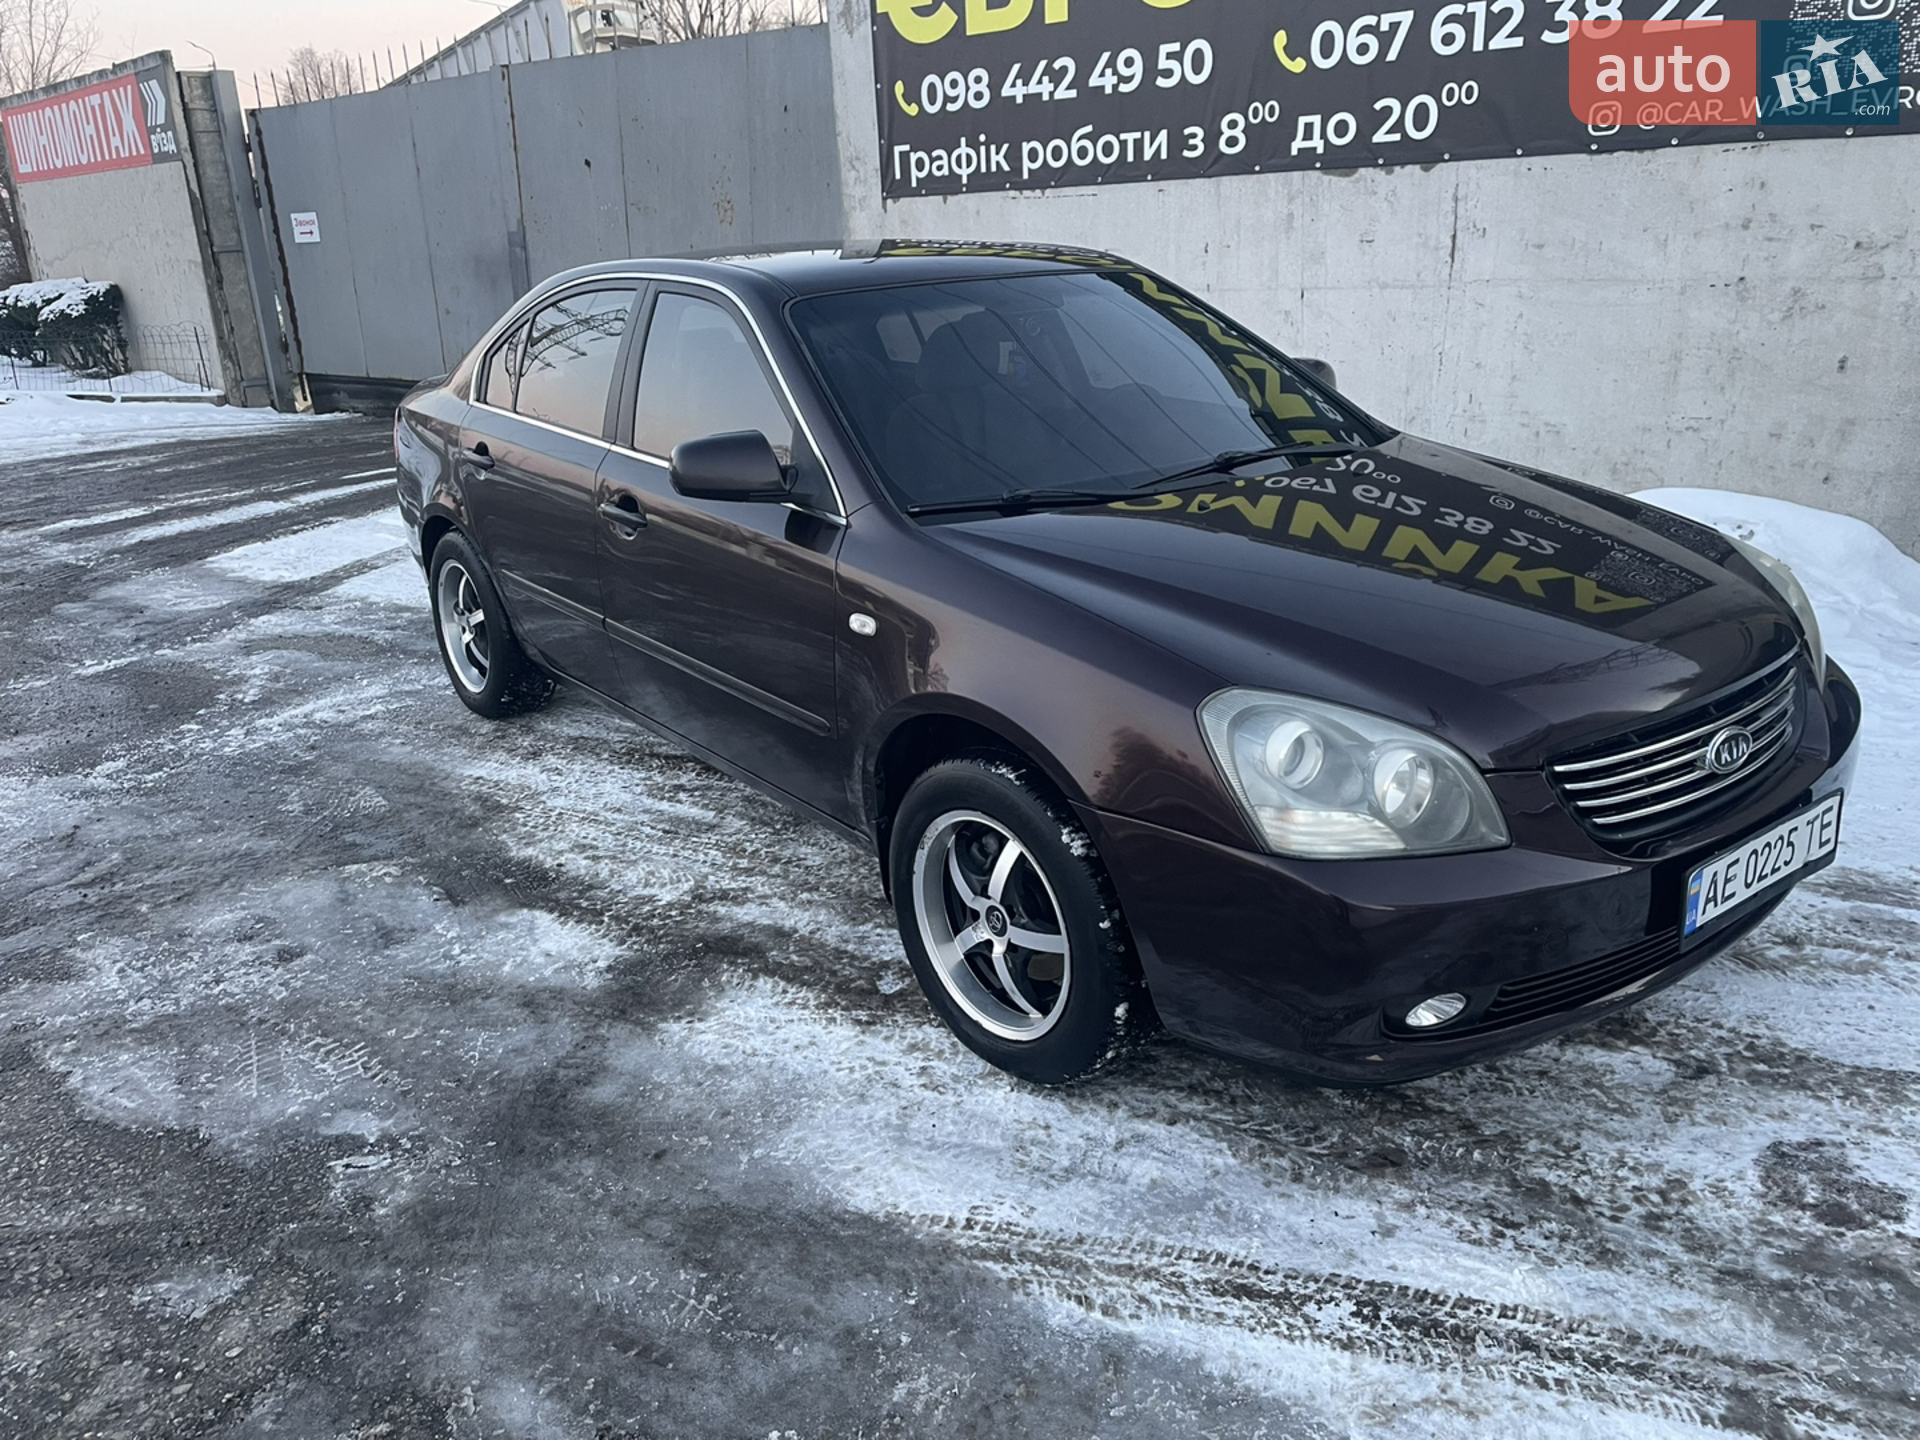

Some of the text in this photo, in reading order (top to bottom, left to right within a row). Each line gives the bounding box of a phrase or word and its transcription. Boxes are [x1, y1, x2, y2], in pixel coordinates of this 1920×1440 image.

[1310, 10, 1414, 69] 067
[1430, 0, 1524, 56] 612
[1540, 0, 1624, 44] 38
[920, 38, 1214, 115] 098 442 49 50
[7, 84, 145, 173] ШИНОМОНТАЖ
[893, 133, 1010, 186] Графік
[1022, 124, 1168, 178] роботи
[1290, 111, 1357, 156] до
[1718, 733, 1749, 766] KIA
[1701, 804, 1835, 917] AE 0225 TE
